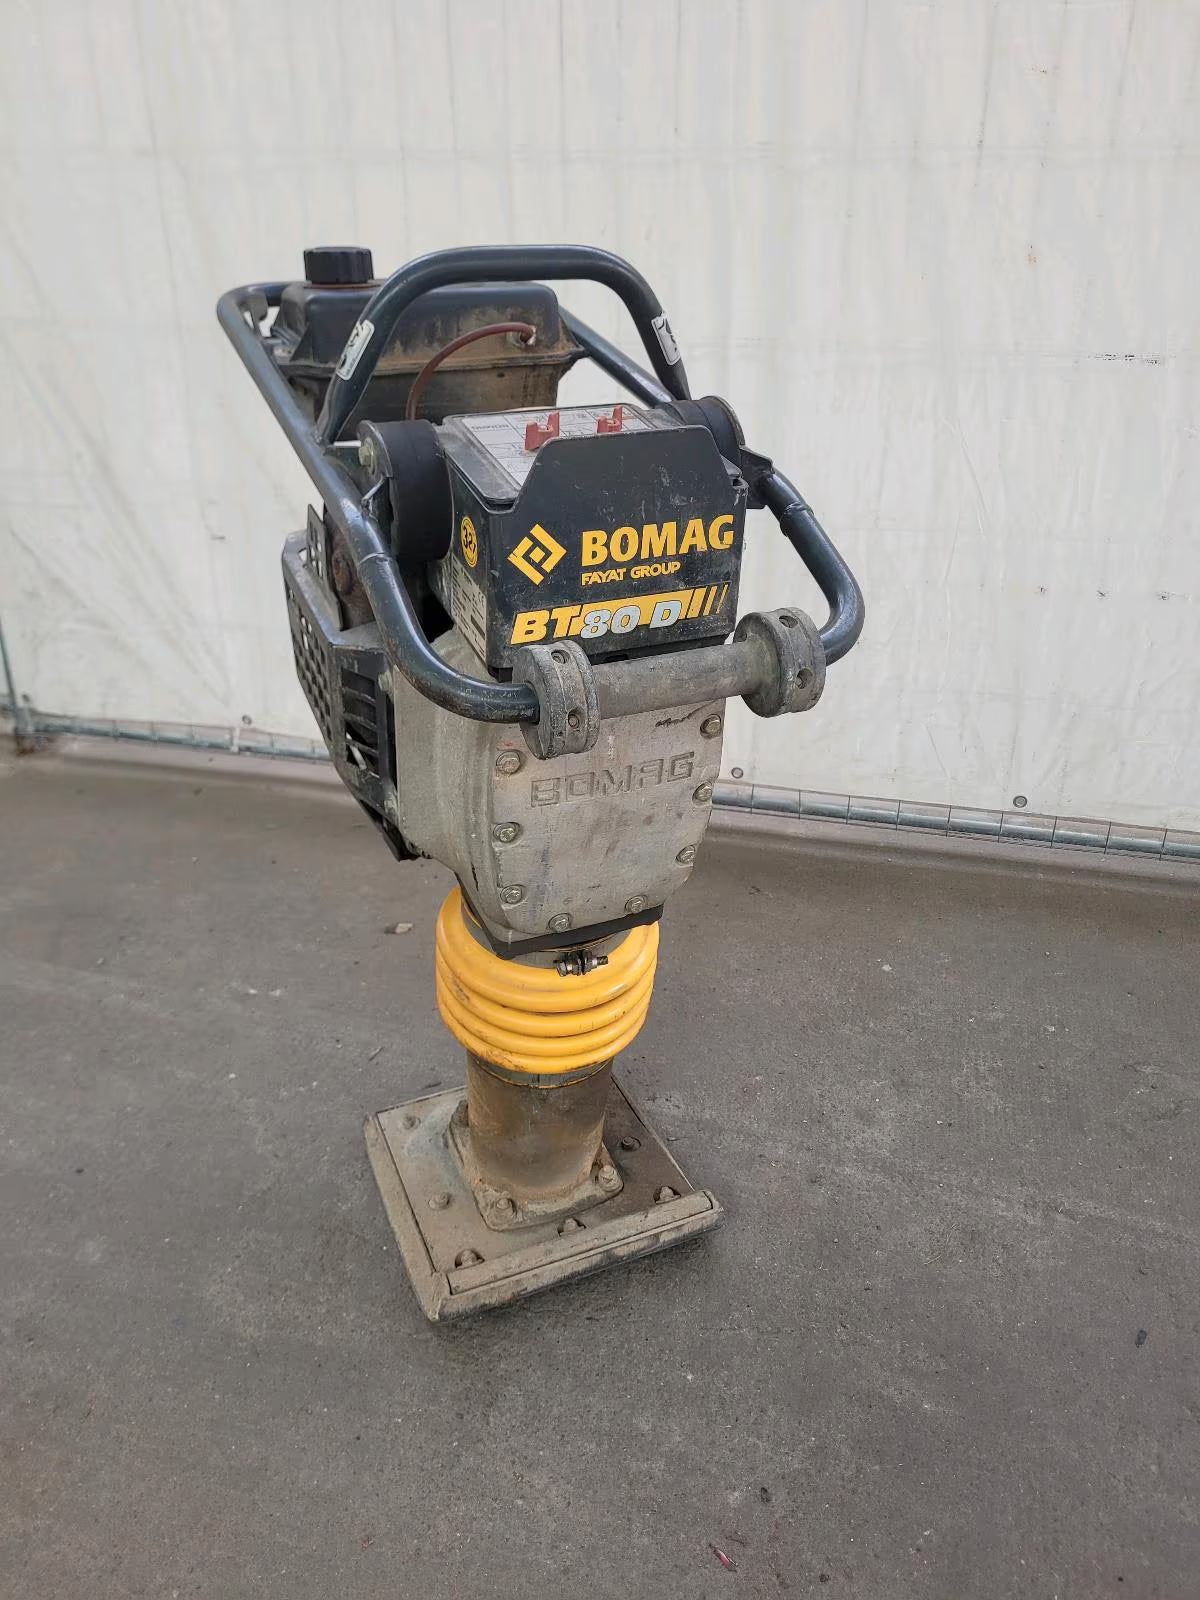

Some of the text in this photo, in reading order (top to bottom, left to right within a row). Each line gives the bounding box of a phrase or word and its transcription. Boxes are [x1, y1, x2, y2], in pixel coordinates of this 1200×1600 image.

[581, 514, 735, 567] BOMAG
[581, 560, 682, 586] FAYAT GROUP
[530, 751, 695, 808] BOMAG
